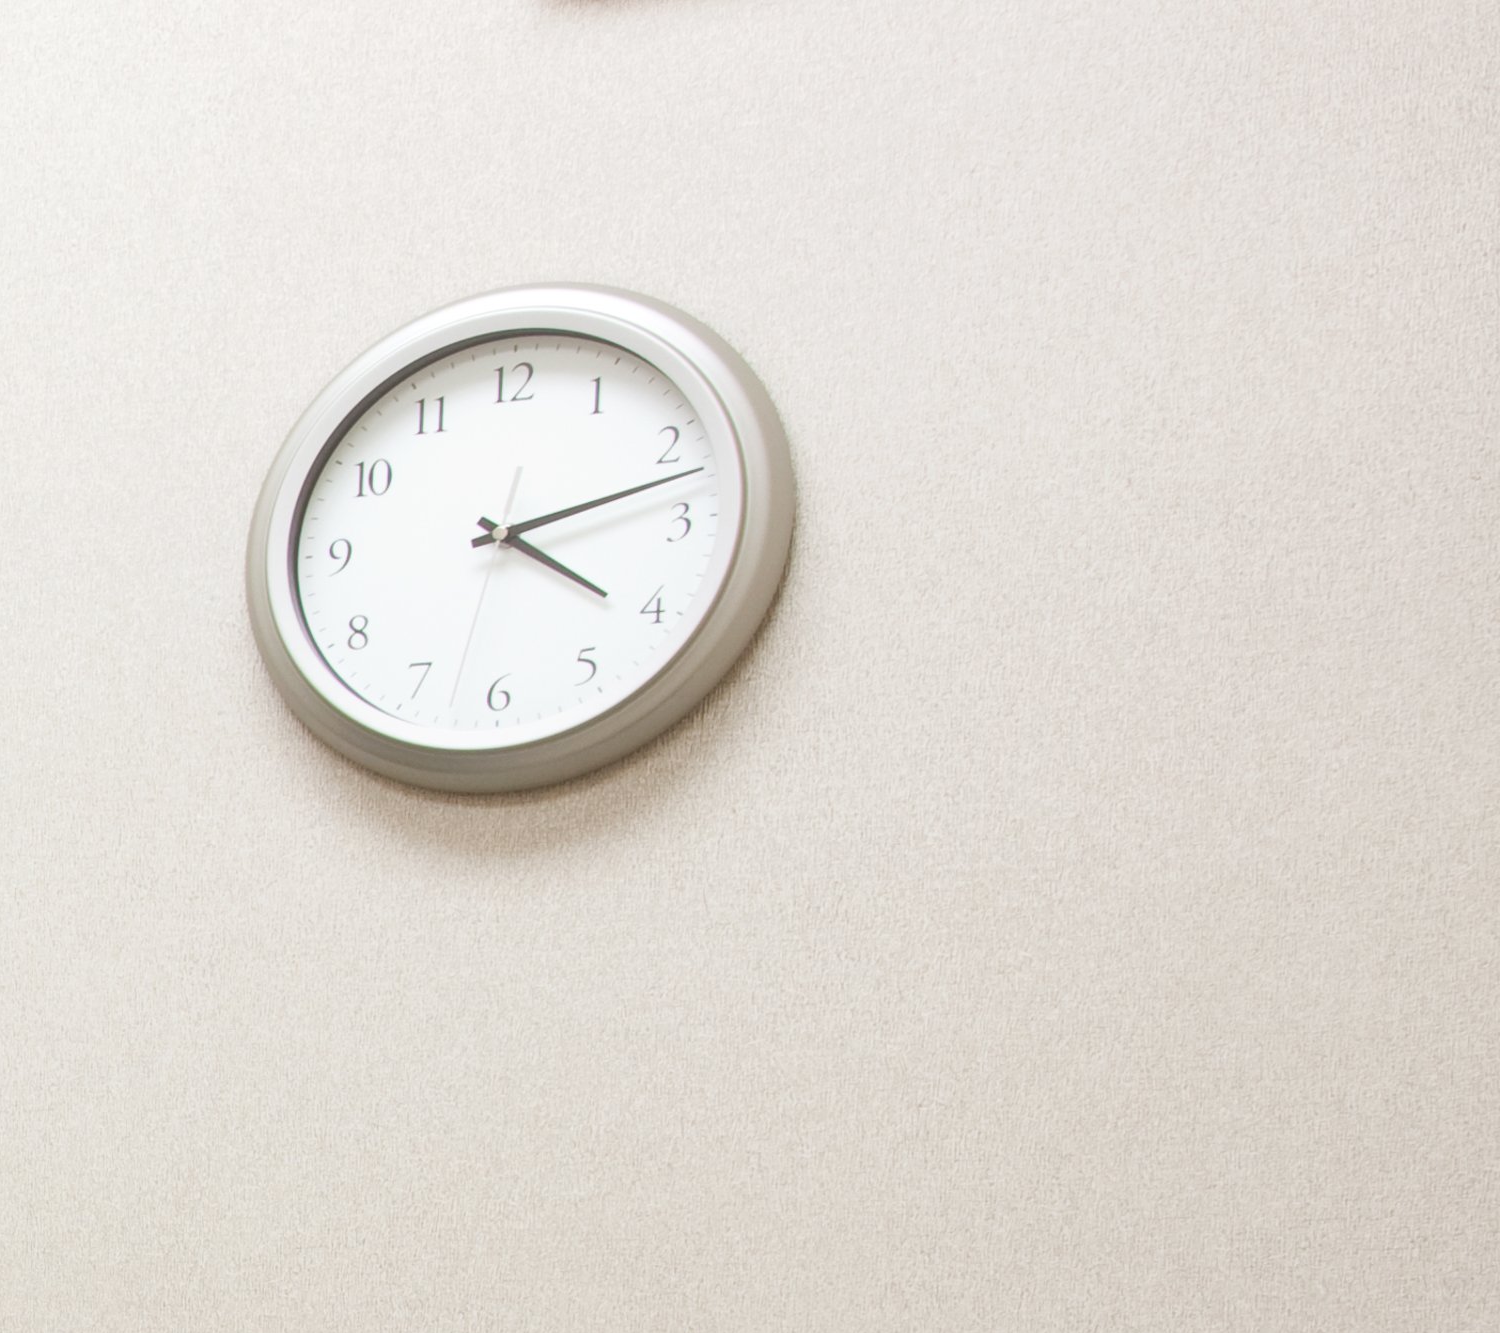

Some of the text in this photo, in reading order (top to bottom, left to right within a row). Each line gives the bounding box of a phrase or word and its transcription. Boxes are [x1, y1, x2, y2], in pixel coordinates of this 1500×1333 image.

[494, 362, 535, 403] 12
[590, 376, 603, 414] 1
[415, 396, 448, 434] 11
[656, 426, 680, 464] 2
[355, 458, 393, 497] 10
[667, 503, 691, 542] 3
[328, 539, 353, 576] 9
[640, 585, 665, 624] 4
[348, 616, 368, 649] 8
[408, 662, 432, 699] 7
[574, 647, 597, 686] 5
[487, 674, 511, 711] 6
